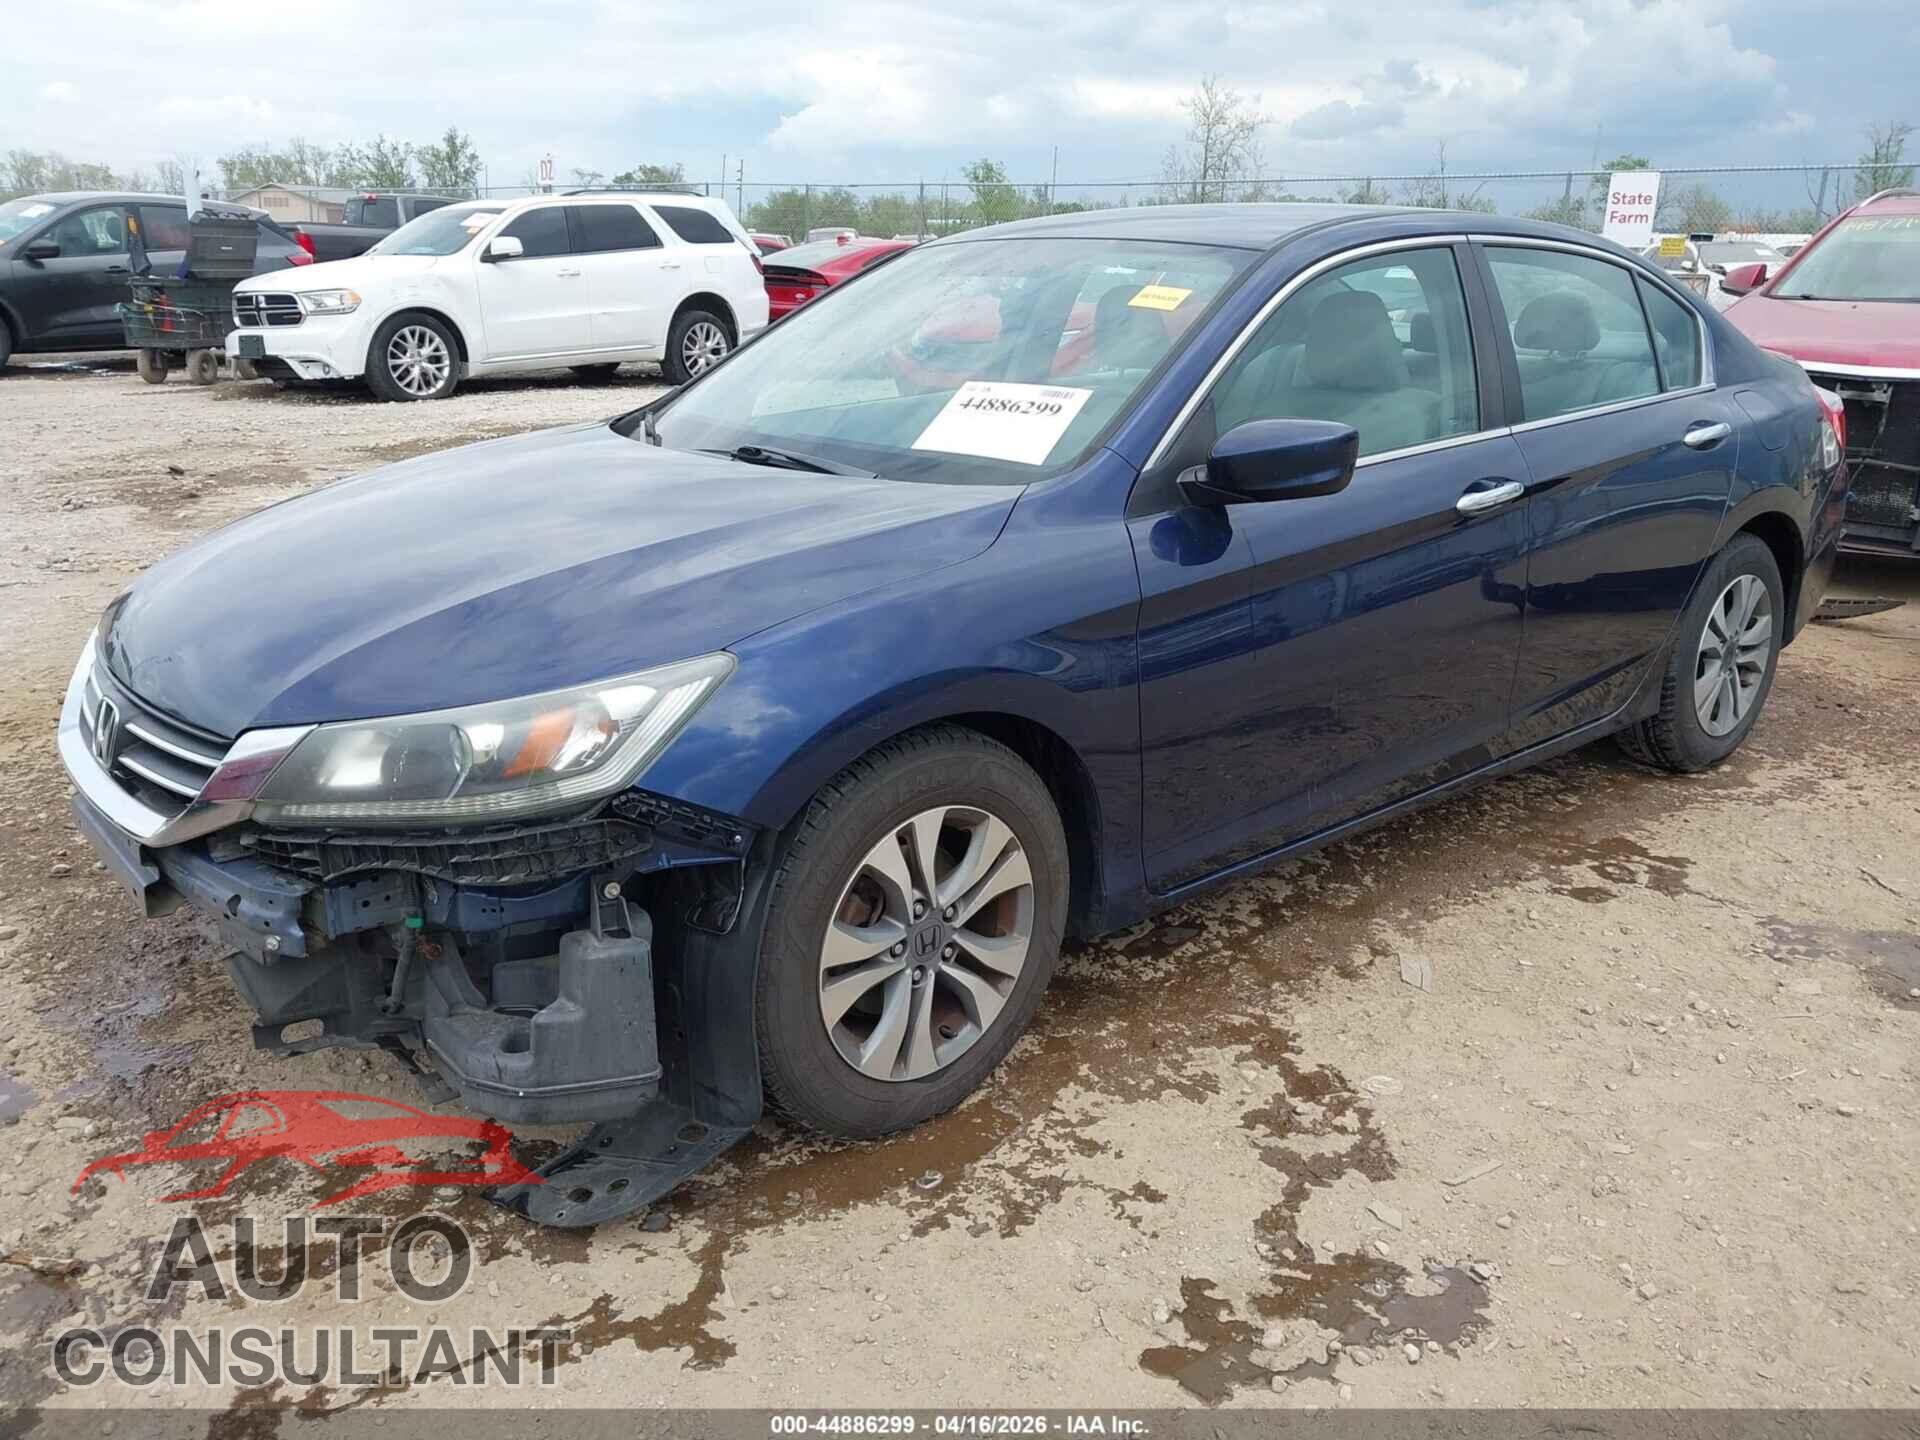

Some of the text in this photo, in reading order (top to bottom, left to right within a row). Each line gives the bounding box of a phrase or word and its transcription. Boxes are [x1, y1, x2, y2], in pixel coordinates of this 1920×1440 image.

[1611, 192, 1653, 205] State
[1609, 211, 1649, 224] Farm
[960, 397, 1063, 416] 44886299
